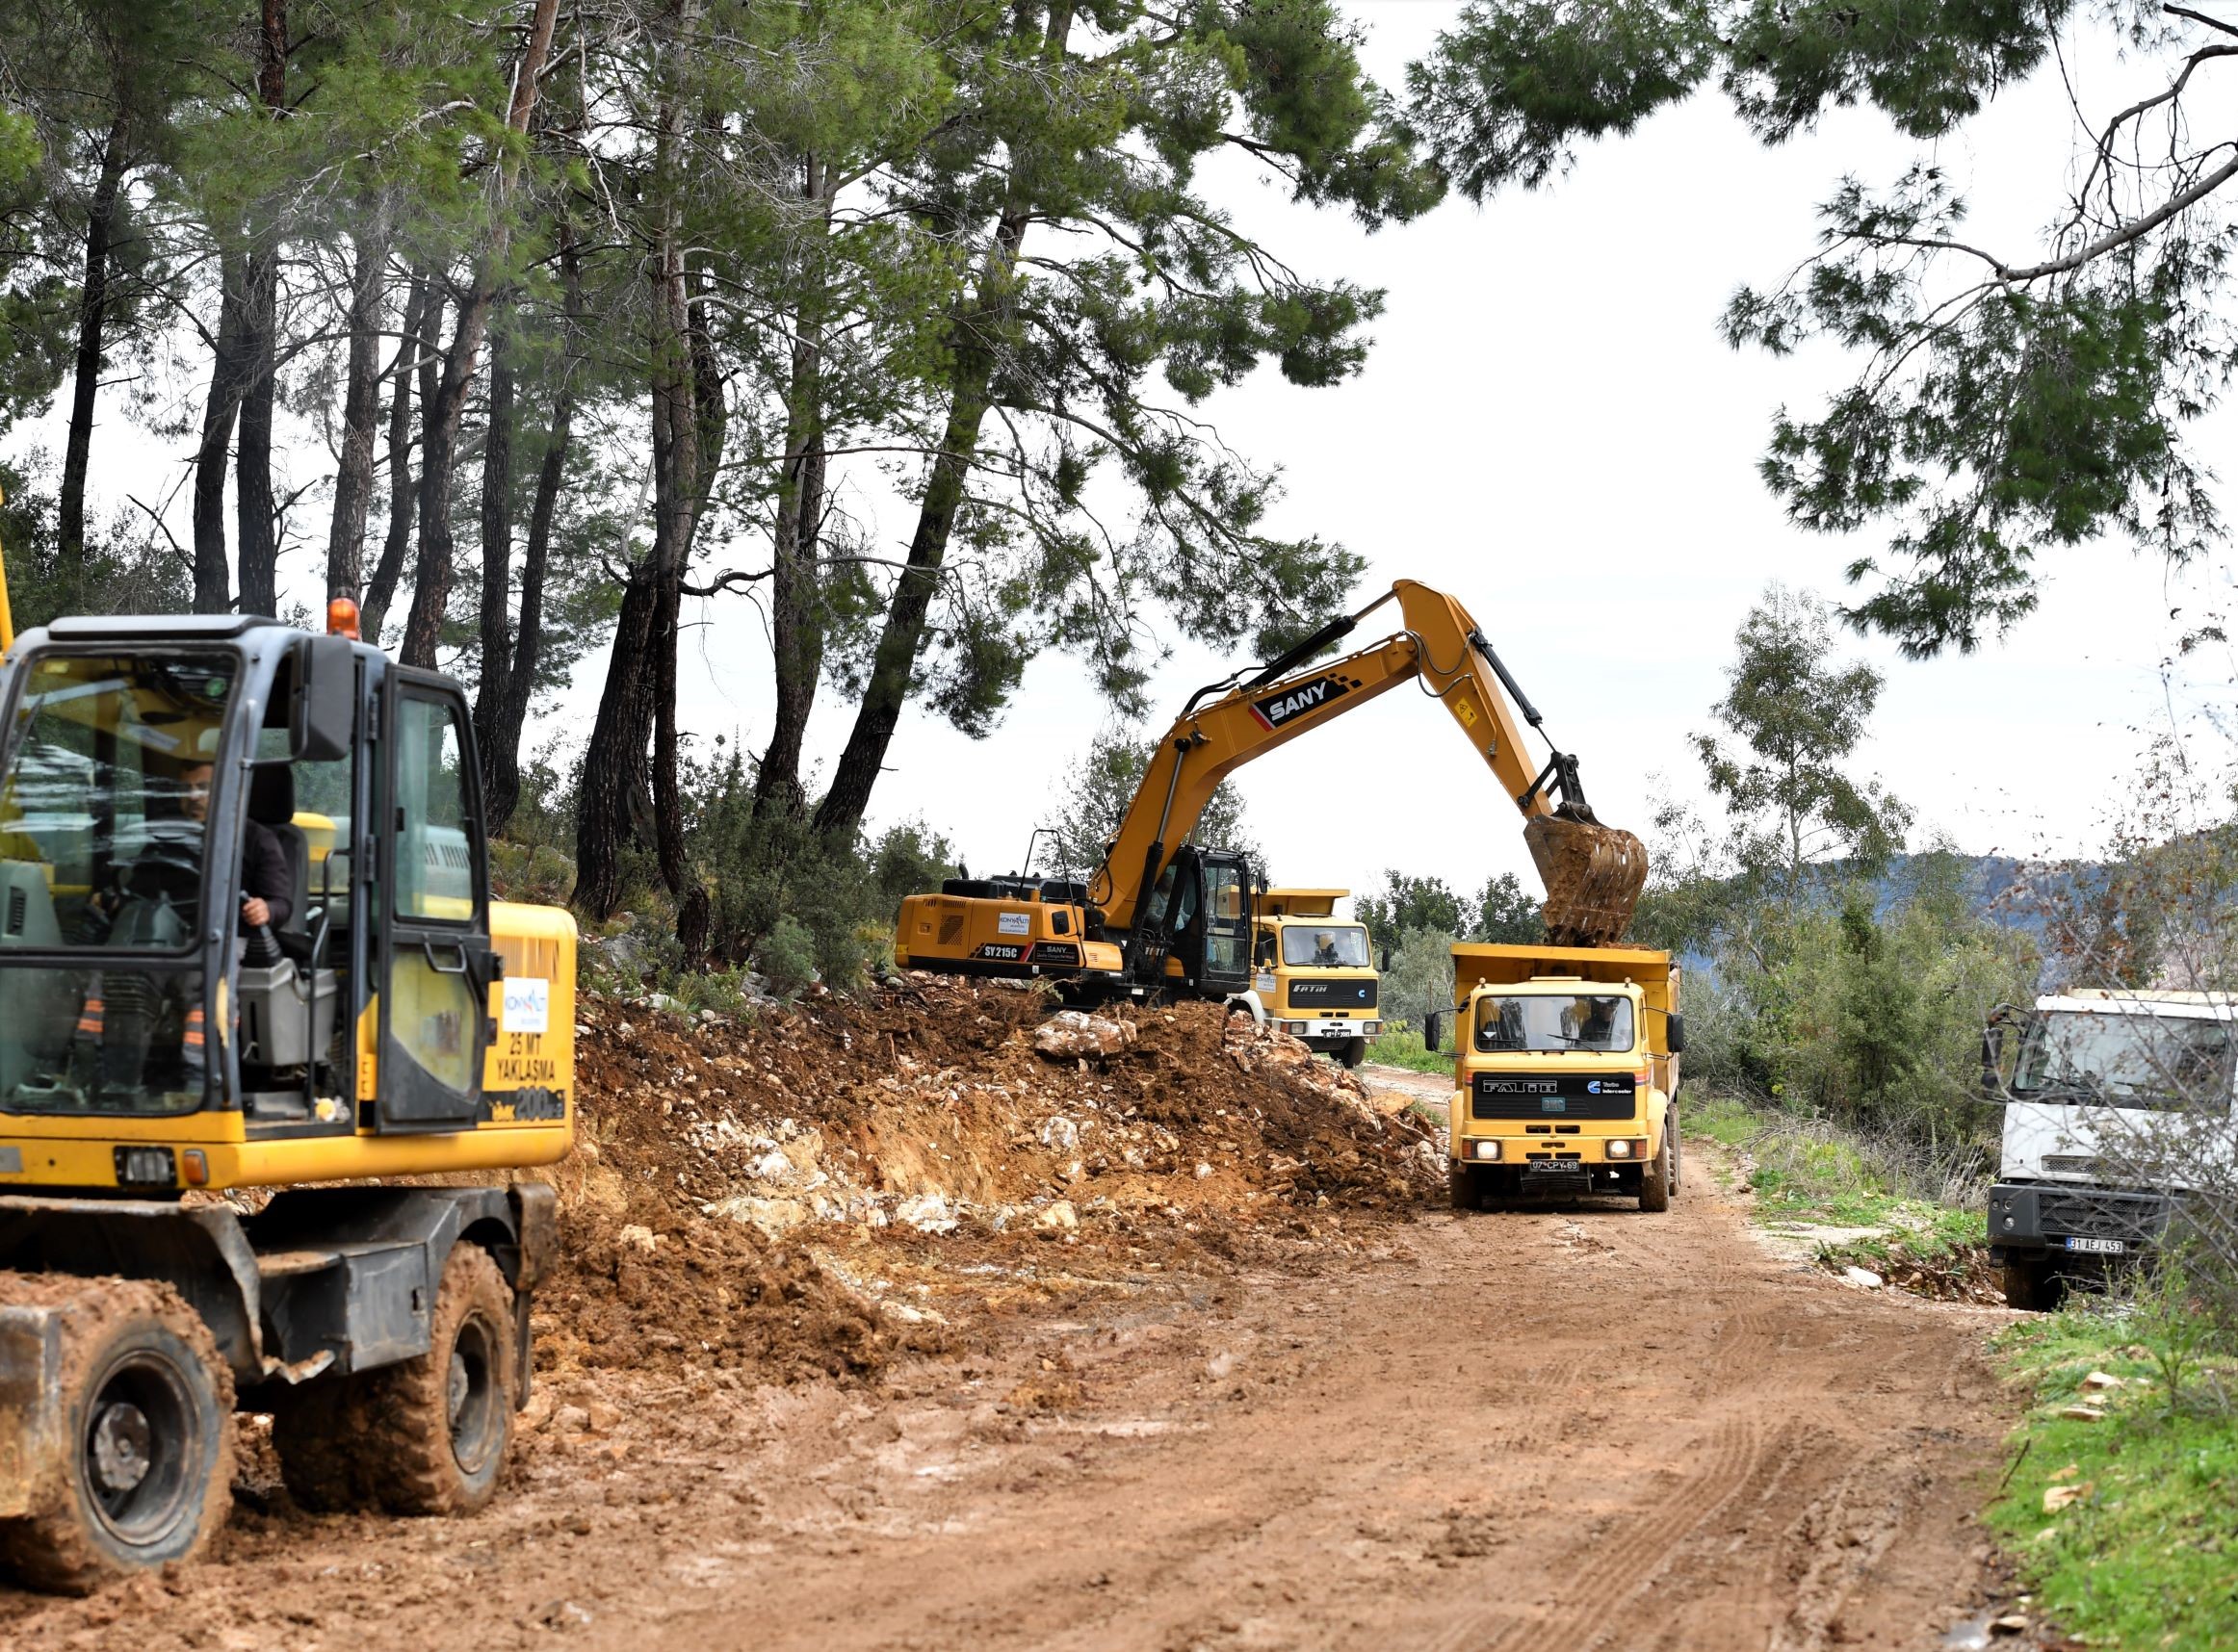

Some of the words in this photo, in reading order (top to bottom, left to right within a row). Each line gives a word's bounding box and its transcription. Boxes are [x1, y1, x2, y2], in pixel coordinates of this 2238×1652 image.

[1269, 681, 1327, 722] SANY
[509, 1032, 522, 1055] 25
[496, 1061, 556, 1083] YAKLAŞMA
[1543, 1099, 1564, 1109] BMC
[1547, 1161, 1565, 1170] CPY
[1567, 1161, 1577, 1170] 69
[2071, 1239, 2080, 1249] 31
[2085, 1240, 2100, 1250] AEJ
[2105, 1241, 2121, 1252] 453
